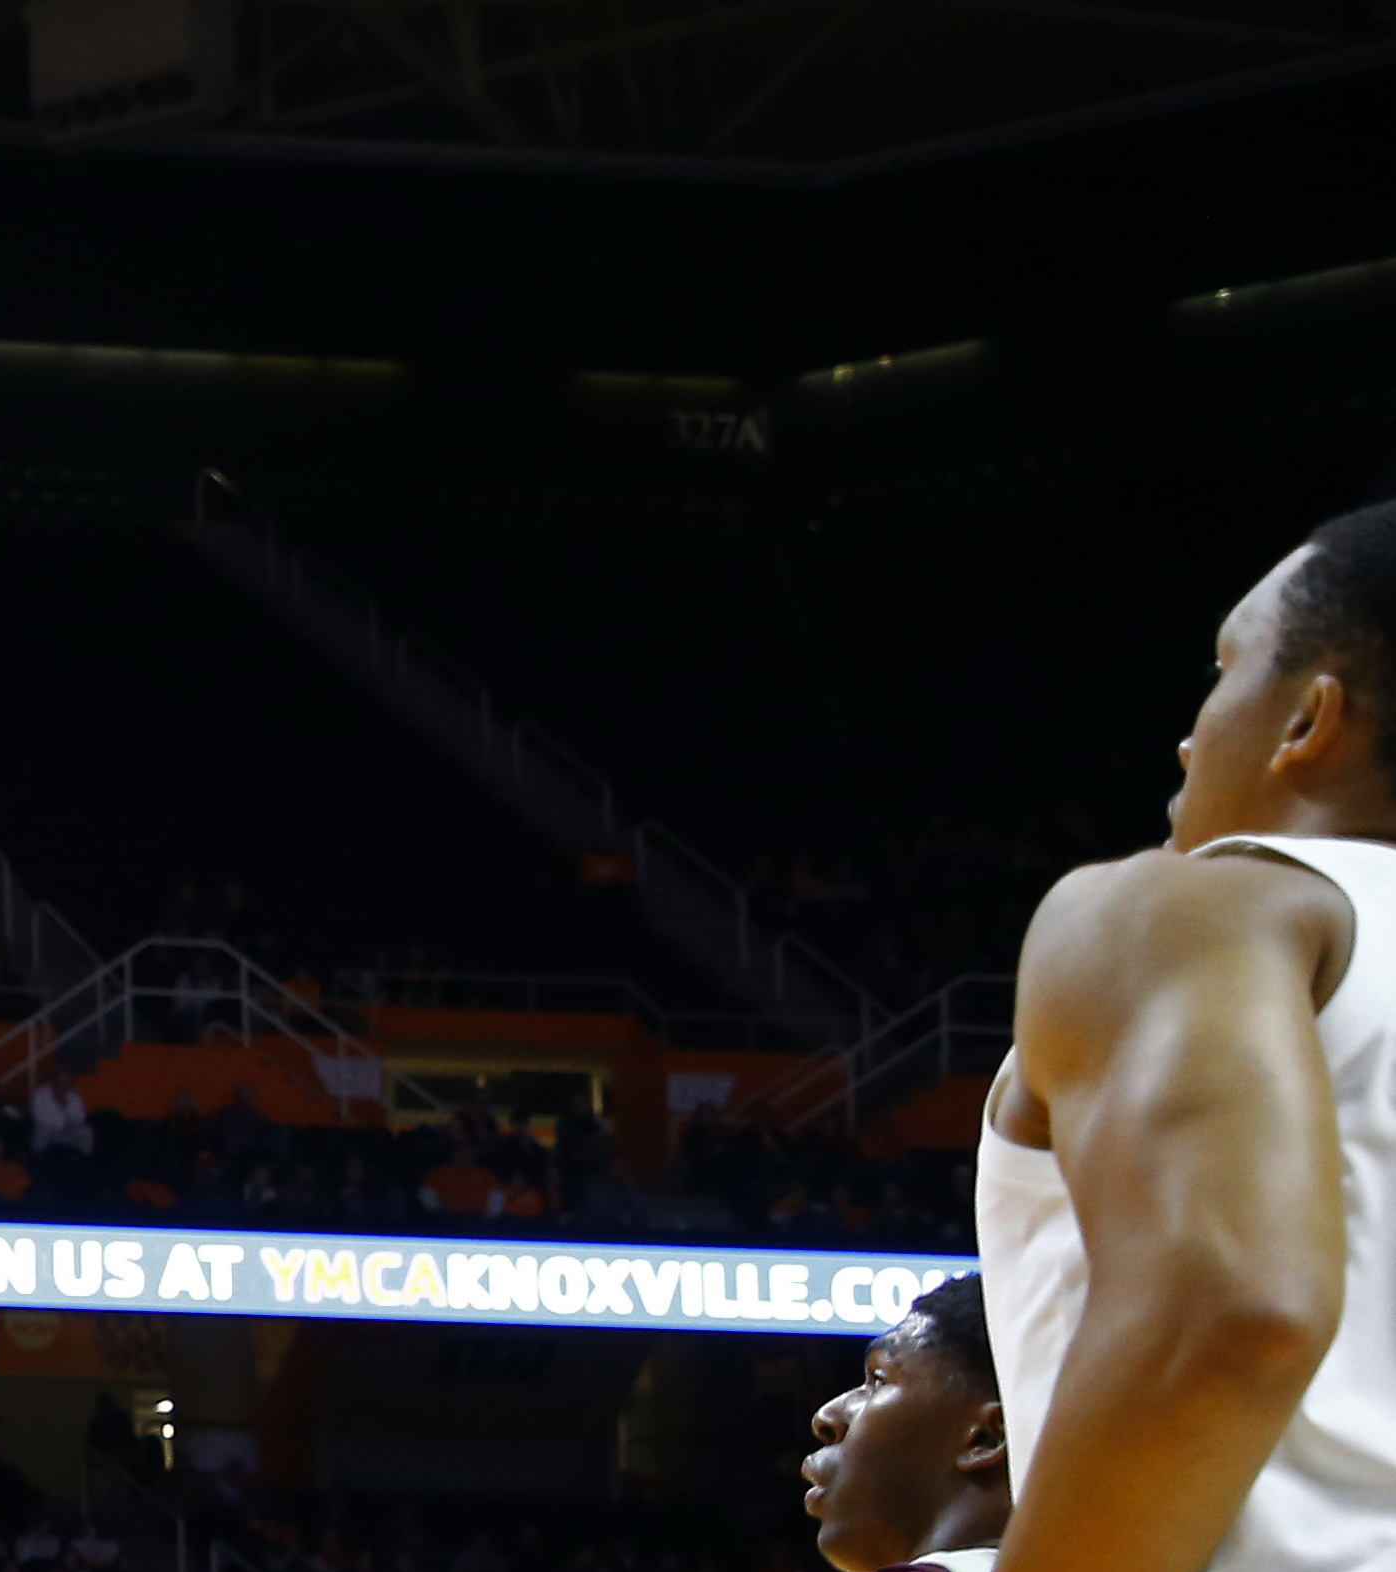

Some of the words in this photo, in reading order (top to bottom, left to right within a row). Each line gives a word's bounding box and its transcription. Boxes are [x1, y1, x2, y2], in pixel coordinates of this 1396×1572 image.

[666, 408, 767, 453] 327A
[51, 1239, 146, 1299] US
[158, 1243, 245, 1301] AT
